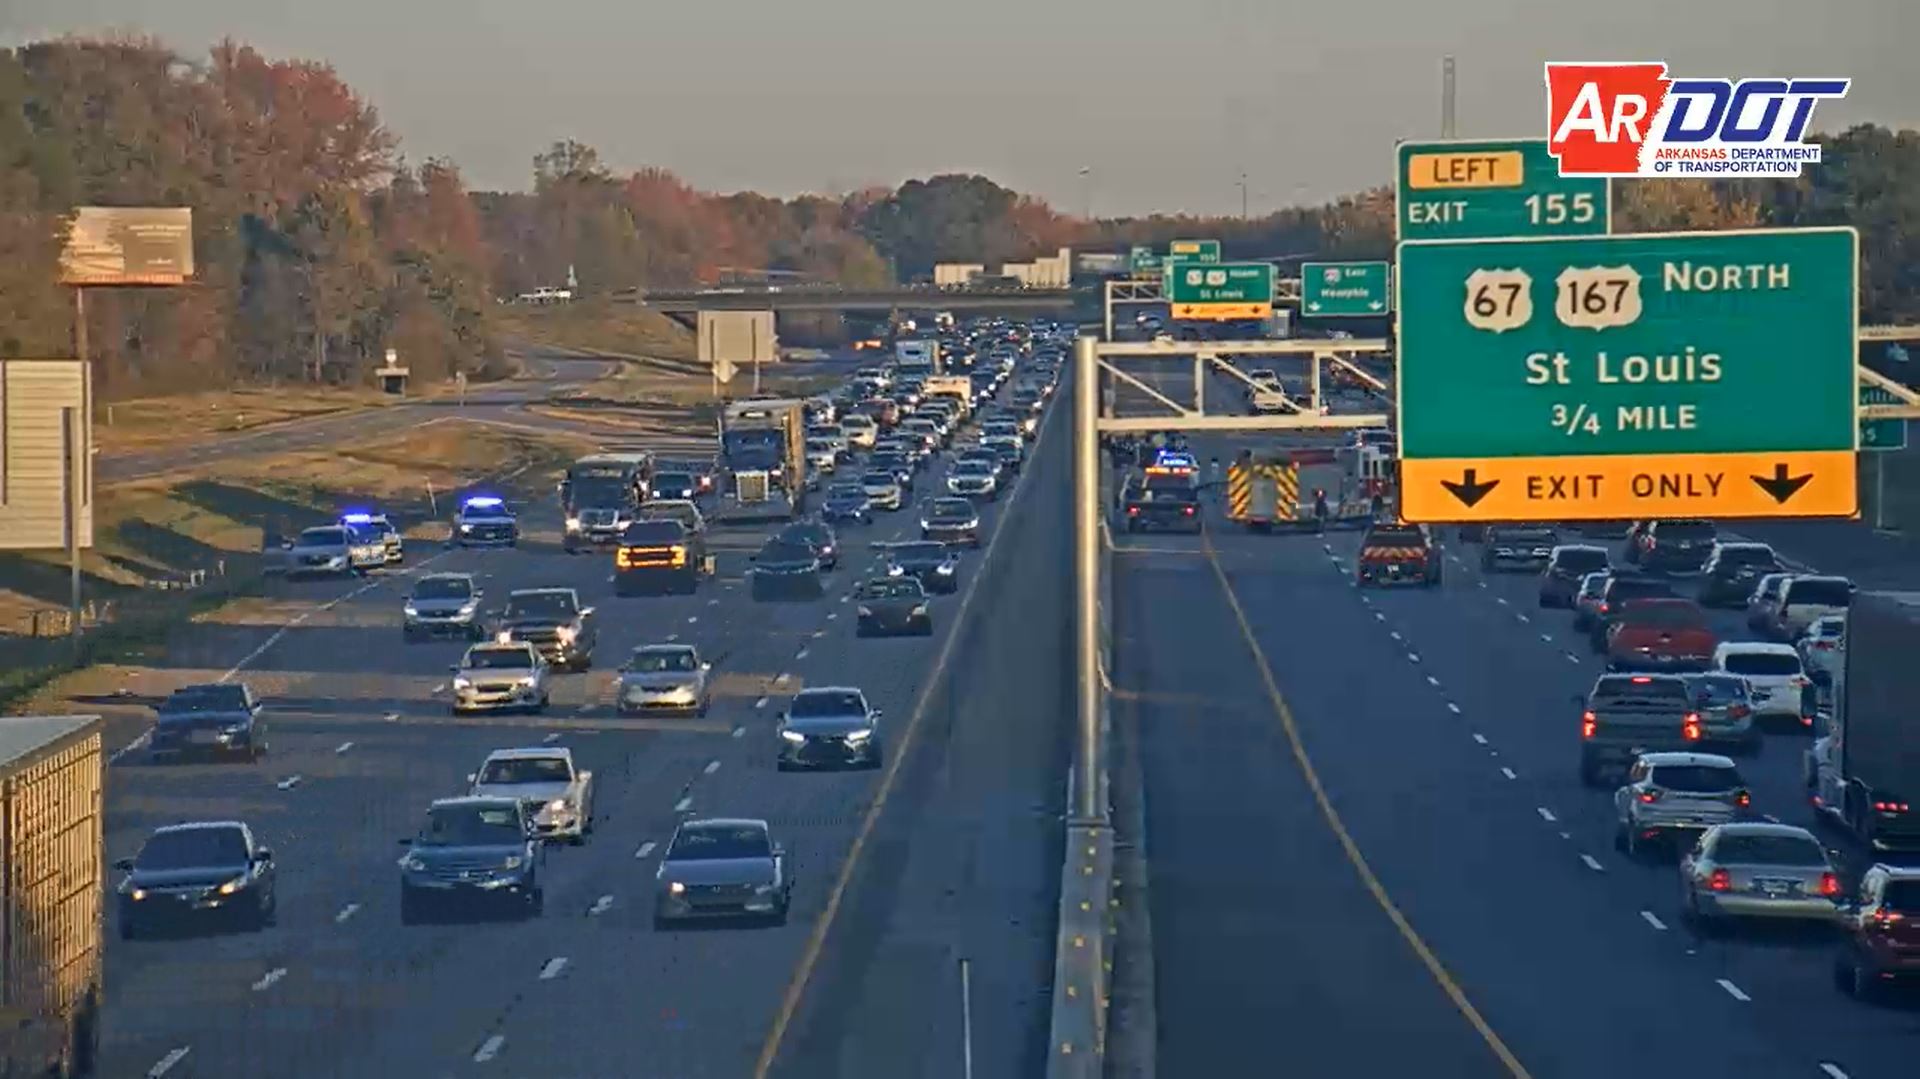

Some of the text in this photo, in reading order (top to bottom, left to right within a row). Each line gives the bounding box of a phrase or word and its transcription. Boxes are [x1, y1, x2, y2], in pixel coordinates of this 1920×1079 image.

[1433, 158, 1498, 182] LEFT
[1408, 194, 1594, 224] EXIT 155
[1473, 262, 1790, 318] 67 167 NORTH
[1526, 346, 1722, 384] St Louis
[1551, 404, 1696, 435] 3/4 MILE
[1527, 473, 1725, 499] EXIT ONLY
